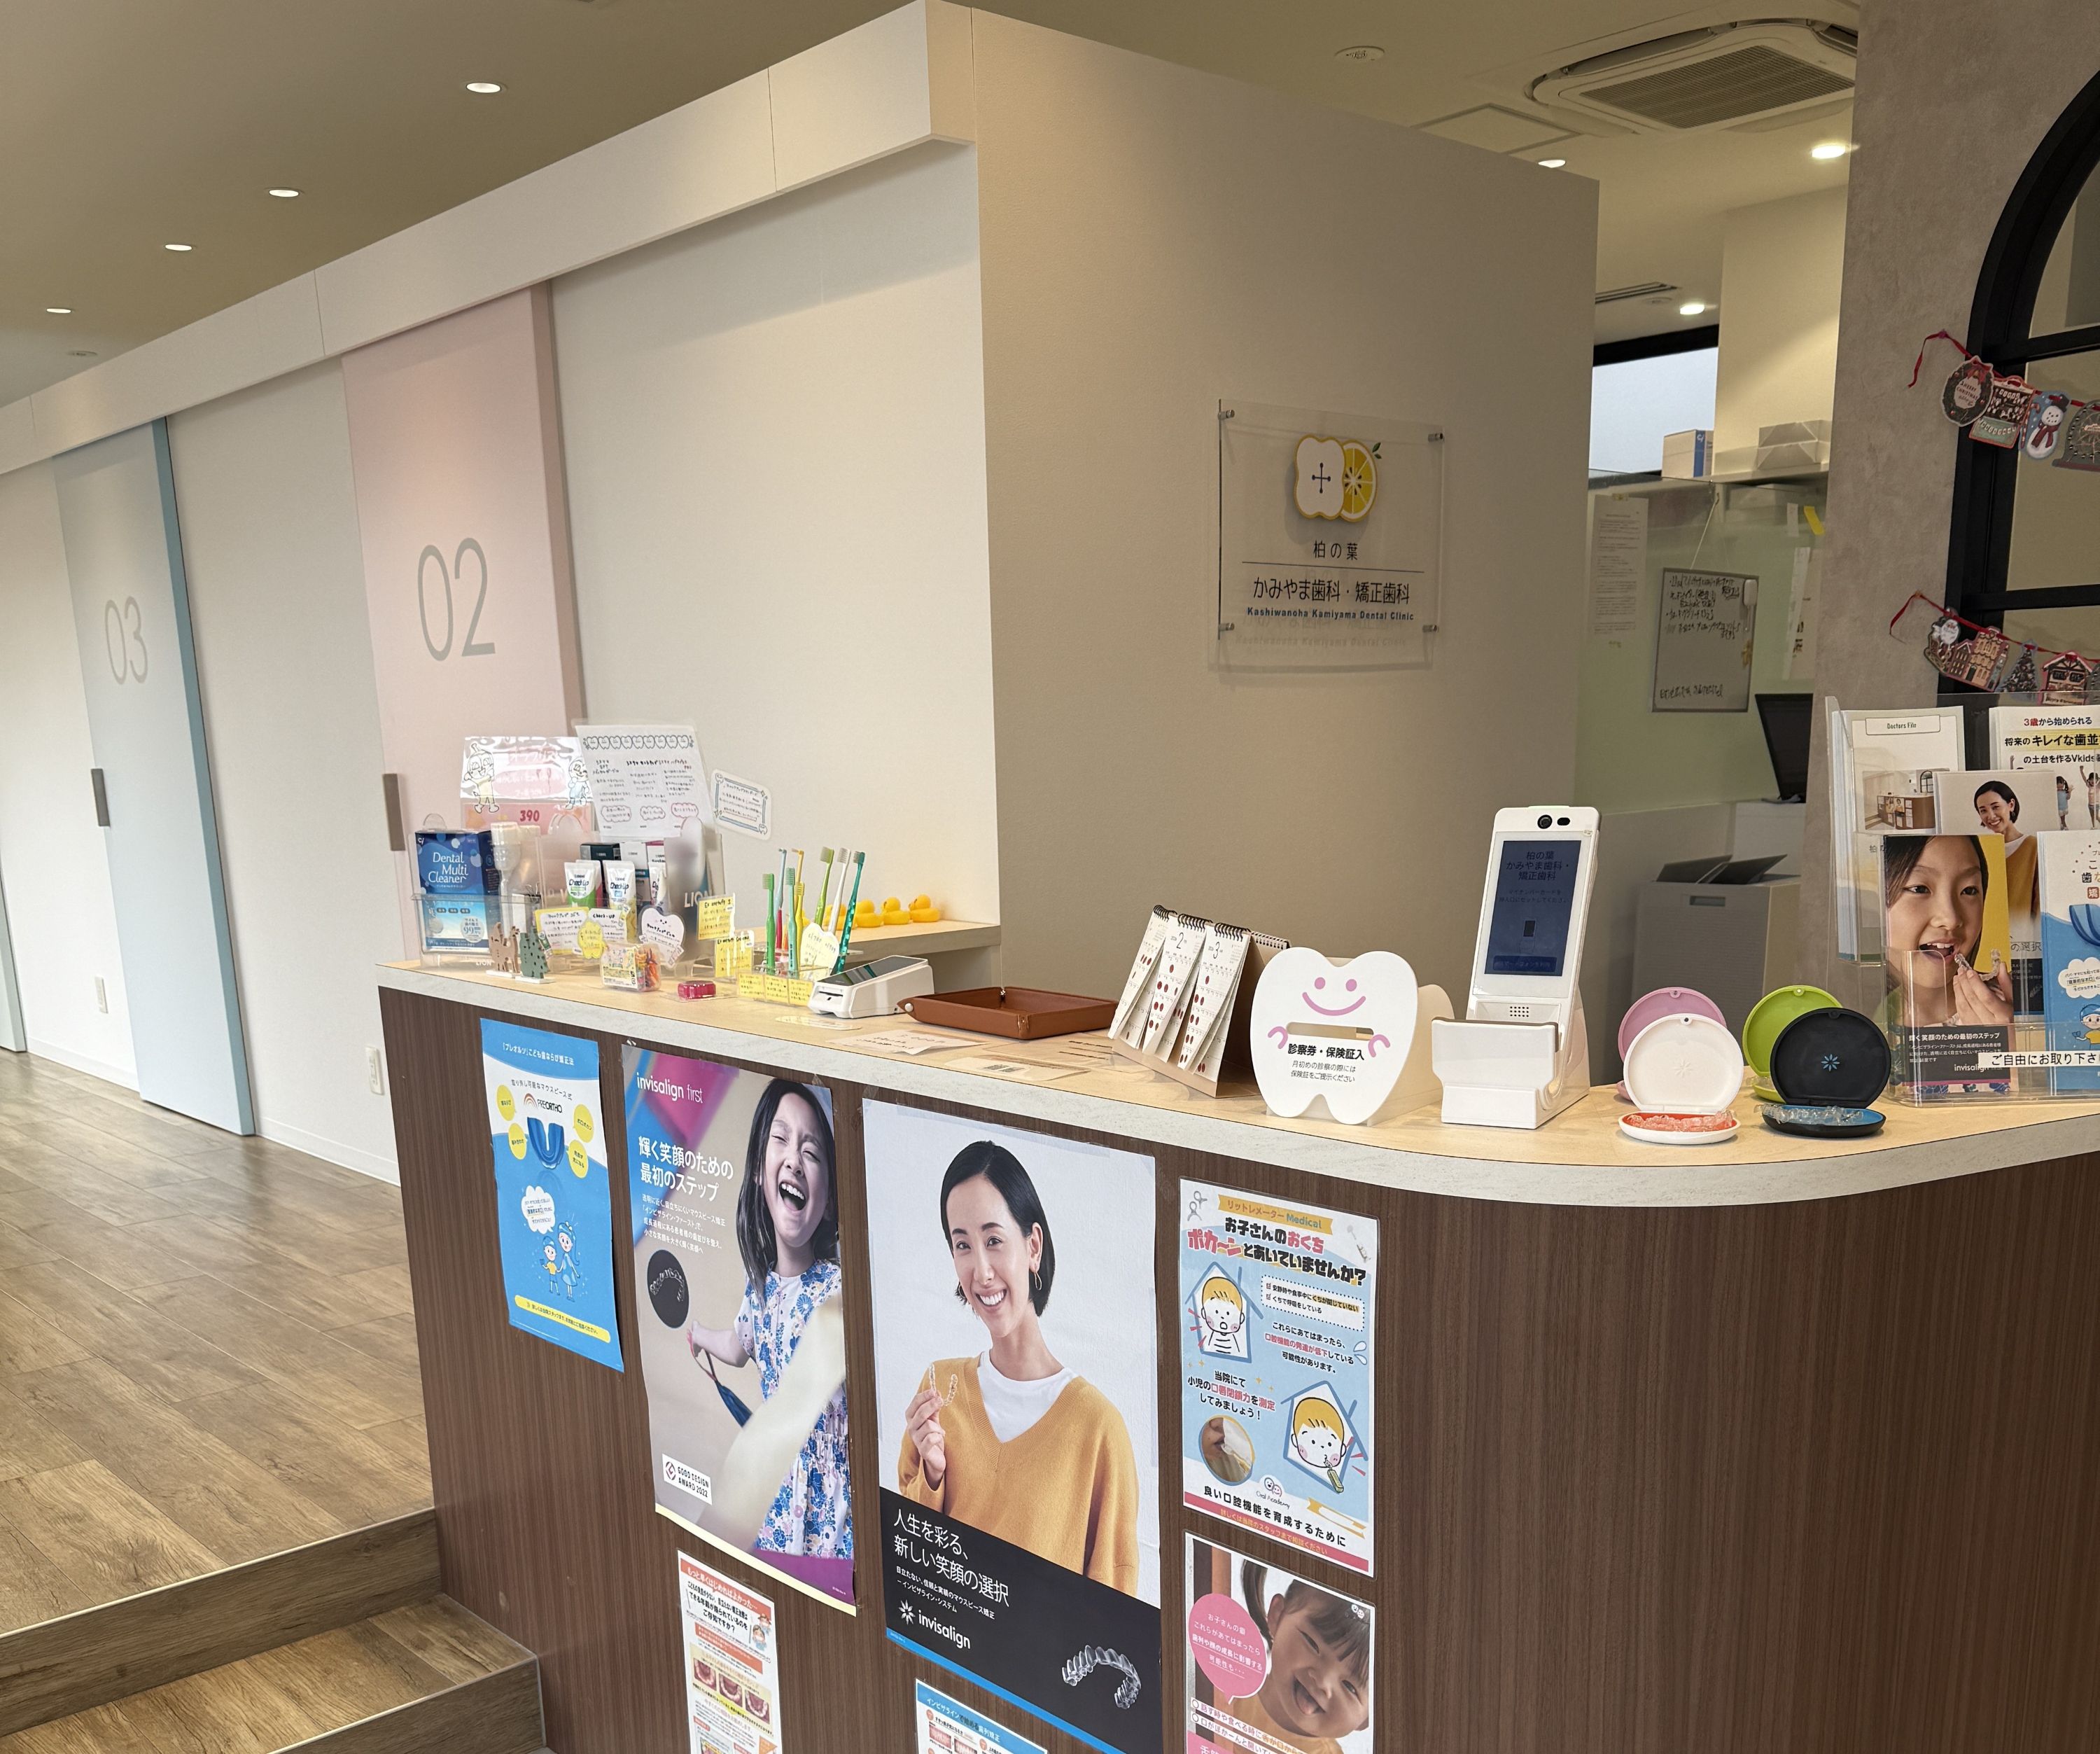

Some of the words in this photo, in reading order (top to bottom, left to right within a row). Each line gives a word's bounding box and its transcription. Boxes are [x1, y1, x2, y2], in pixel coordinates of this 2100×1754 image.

[1313, 541, 1358, 560] 柏の葉
[417, 538, 496, 661] 02
[1253, 577, 1410, 604] かみやま歯科・矯正歯科
[1247, 607, 1308, 618] Kashiwanoha
[1312, 609, 1357, 620] Kamiyama
[1360, 611, 1387, 620] Dental
[1390, 612, 1414, 621] Clinic
[104, 596, 148, 685] 03
[2024, 717, 2092, 726] 3歳から始められる
[2005, 734, 2100, 746] 将来のキレイな歯並
[520, 809, 540, 822] 390
[433, 852, 465, 863] Dental
[1527, 851, 1554, 860] 柏の葉
[428, 871, 467, 883] Cleaner
[442, 864, 469, 876] Multi
[1518, 870, 1556, 880] 矯正歯科
[1176, 932, 1184, 949] 2
[1213, 941, 1220, 959] 3
[1909, 1033, 2001, 1041] 輝く笑顔のための最初のステップ
[1288, 1043, 1364, 1061] 診察券・保険証入
[1991, 1052, 2100, 1066] ご自由にお取り下さ
[1291, 1070, 1355, 1083] 保険証をご提示ください
[1292, 1060, 1356, 1073] 月初めの診察の際には
[511, 1079, 573, 1101] 取り外し可能なマウスピース式
[637, 1072, 684, 1101] invisalign
[687, 1085, 703, 1104] first
[538, 1099, 563, 1113] PREORTHO
[638, 1136, 734, 1181] 輝く笑顔のための
[640, 1162, 719, 1202] 最初のステップ
[1227, 1199, 1284, 1218] リットレメーター
[1286, 1213, 1322, 1229] Medical
[1225, 1217, 1324, 1254] お子さんのおくち
[1273, 1285, 1359, 1312] 安静時や食事中にくちが閉じていない
[1273, 1296, 1322, 1314] くちで呼吸をしている
[1273, 1322, 1345, 1349] これらにあてはまったら、
[1265, 1333, 1354, 1365] 口腔機能の発達が低下している
[1282, 1351, 1336, 1374] 可能性があります。
[1214, 1370, 1246, 1388] 当院にて
[1187, 1376, 1275, 1411] 小児の口唇閉鎖力を測定
[678, 1466, 691, 1479] GOOD
[692, 1473, 709, 1489] DESIGN
[678, 1477, 695, 1491] AWARD
[696, 1485, 708, 1498] 2022
[1268, 1496, 1290, 1510] Academy
[1204, 1485, 1346, 1547] 良い口腔機能を育成するために
[893, 1508, 969, 1561] 人生を彩る、
[893, 1534, 1009, 1607] 新しい笑顔の選択
[896, 1566, 995, 1620] 目立たない、信頼と実績のマウスピース矯正
[918, 1609, 971, 1649] invisalign
[1194, 1620, 1260, 1655] これらがあてはまったら
